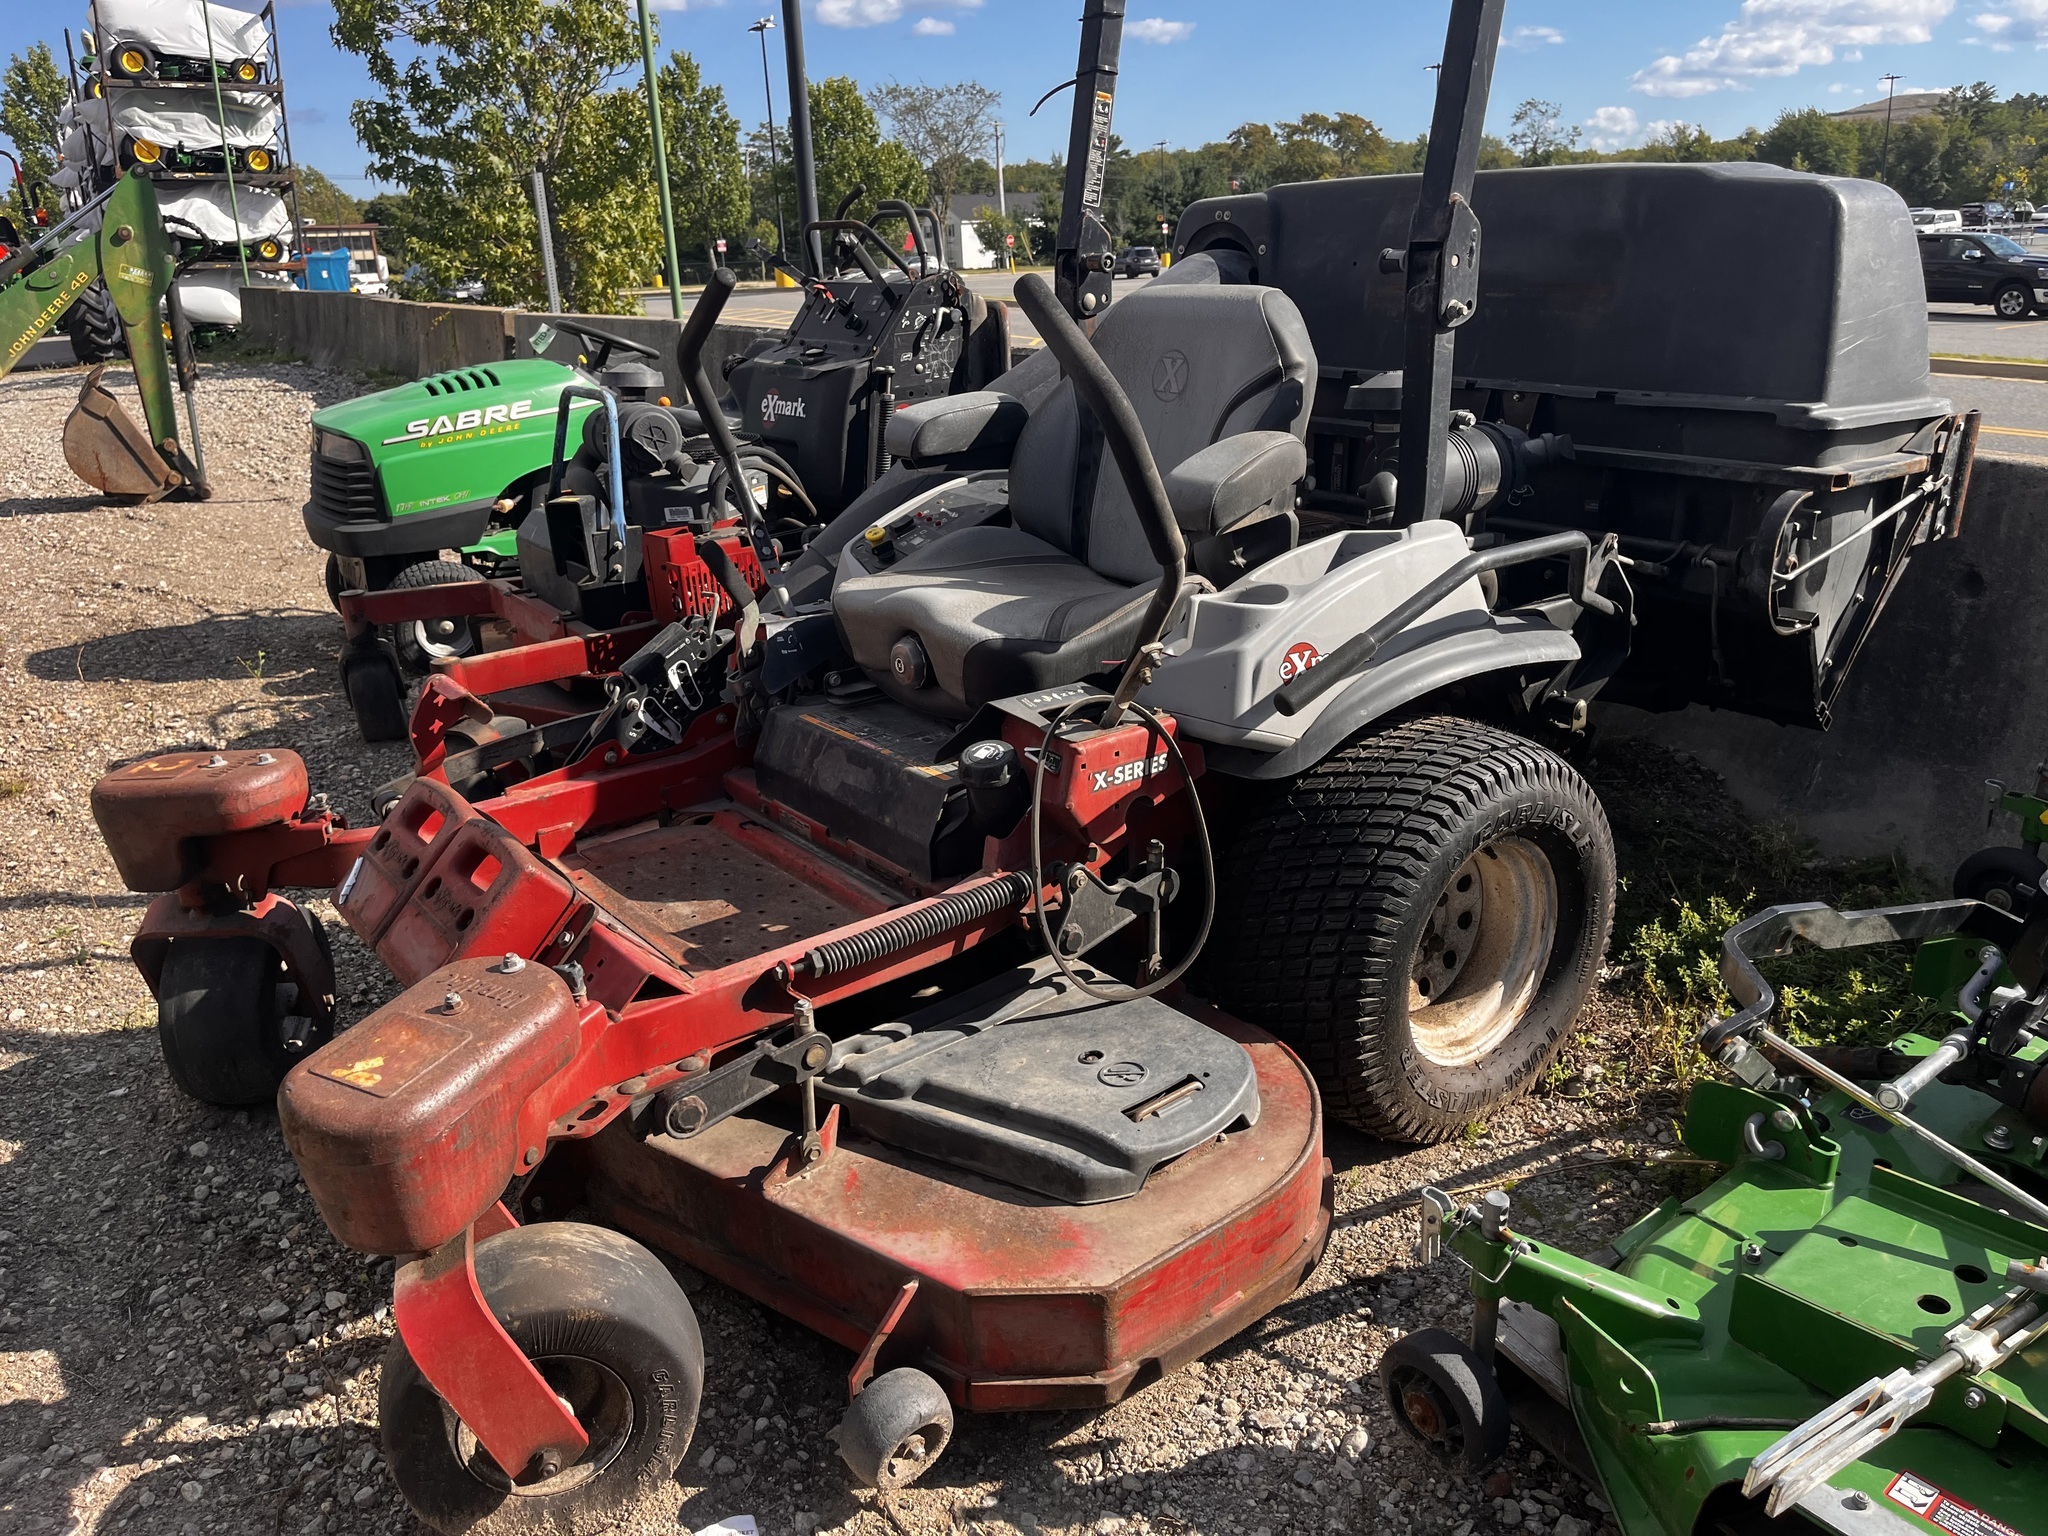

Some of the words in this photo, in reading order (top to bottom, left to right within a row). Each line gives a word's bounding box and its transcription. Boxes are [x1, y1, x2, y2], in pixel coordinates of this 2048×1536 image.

[8, 326, 37, 358] JOHN
[34, 291, 71, 329] DEERE
[406, 400, 532, 437] SABRE
[761, 394, 806, 422] eXmark
[438, 433, 473, 445] JOHN
[480, 423, 521, 437] DEERE
[419, 495, 450, 507] INTEK
[1092, 753, 1168, 792] X-SERIES
[1472, 801, 1596, 858] CARLISLE
[1400, 1049, 1492, 1114] MASTER
